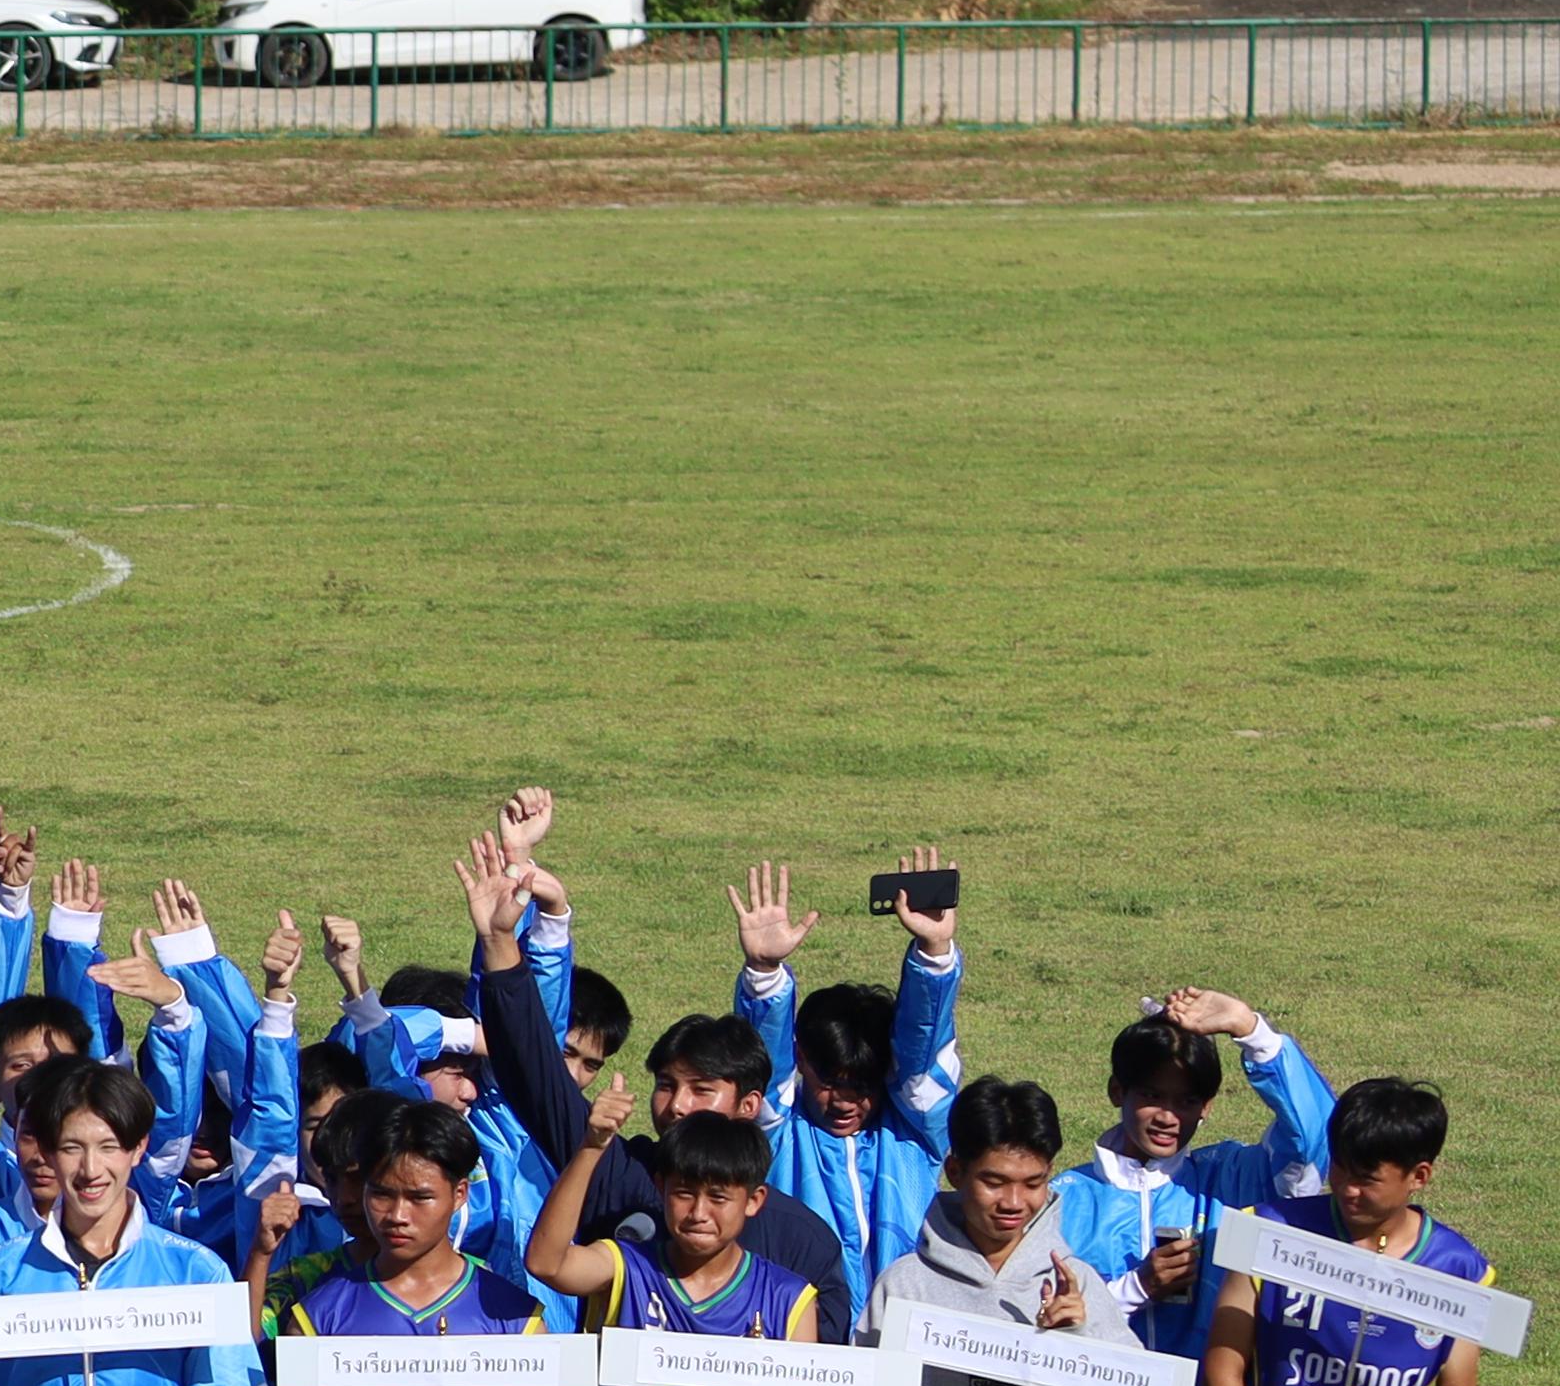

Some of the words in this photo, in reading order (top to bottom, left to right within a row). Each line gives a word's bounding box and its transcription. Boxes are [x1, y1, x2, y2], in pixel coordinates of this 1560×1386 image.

[1271, 1238, 1467, 1319] โรงเรียนสรรพวิทยาคม
[1281, 1287, 1326, 1331] 21
[653, 1345, 856, 1386] วิทยาลัยเทคนิคแม่สอด
